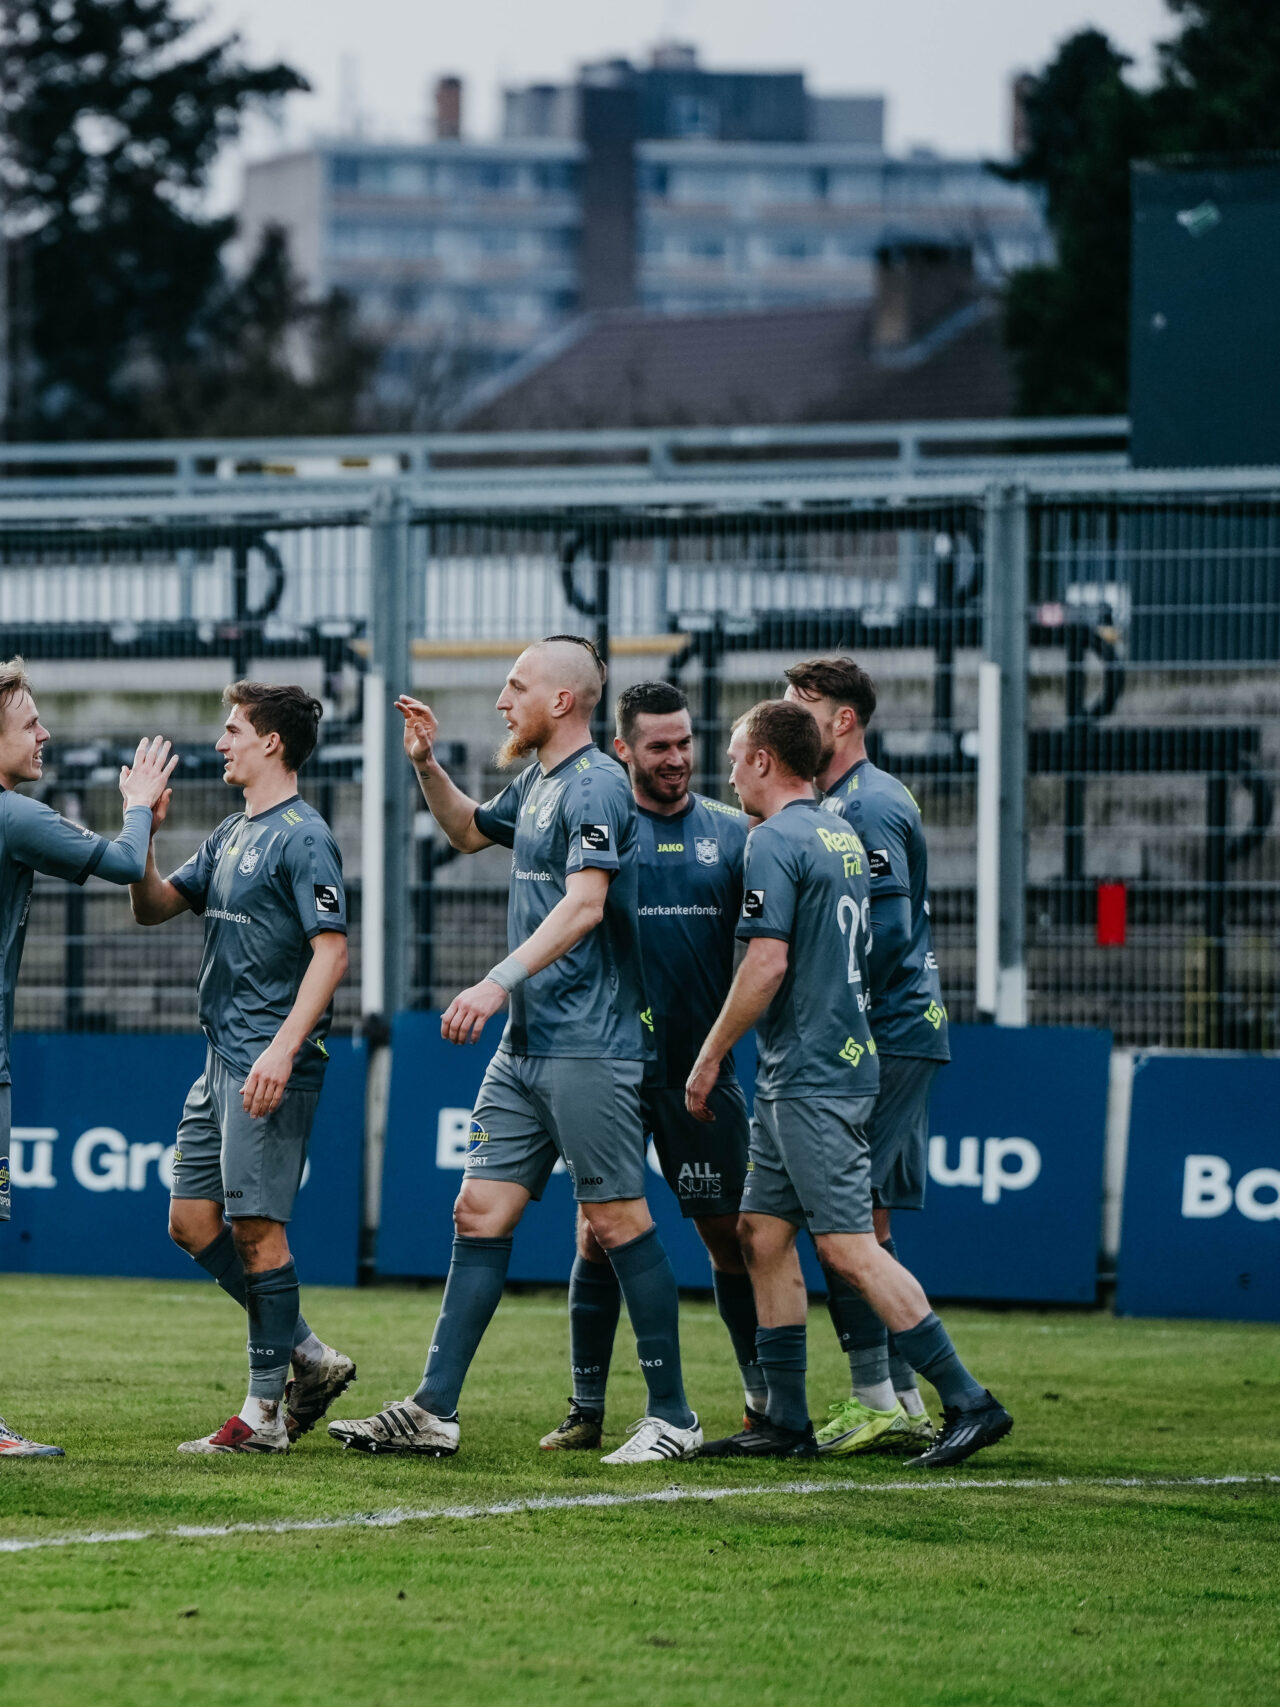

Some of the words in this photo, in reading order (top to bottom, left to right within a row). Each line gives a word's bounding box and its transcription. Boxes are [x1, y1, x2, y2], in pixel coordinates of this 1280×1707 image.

[657, 843, 684, 853] JAKO
[927, 1134, 1043, 1204] up
[581, 1176, 604, 1186] JAKO
[678, 1179, 722, 1193] NUTS
[247, 1346, 275, 1356] AKO
[639, 1358, 663, 1368] AKO
